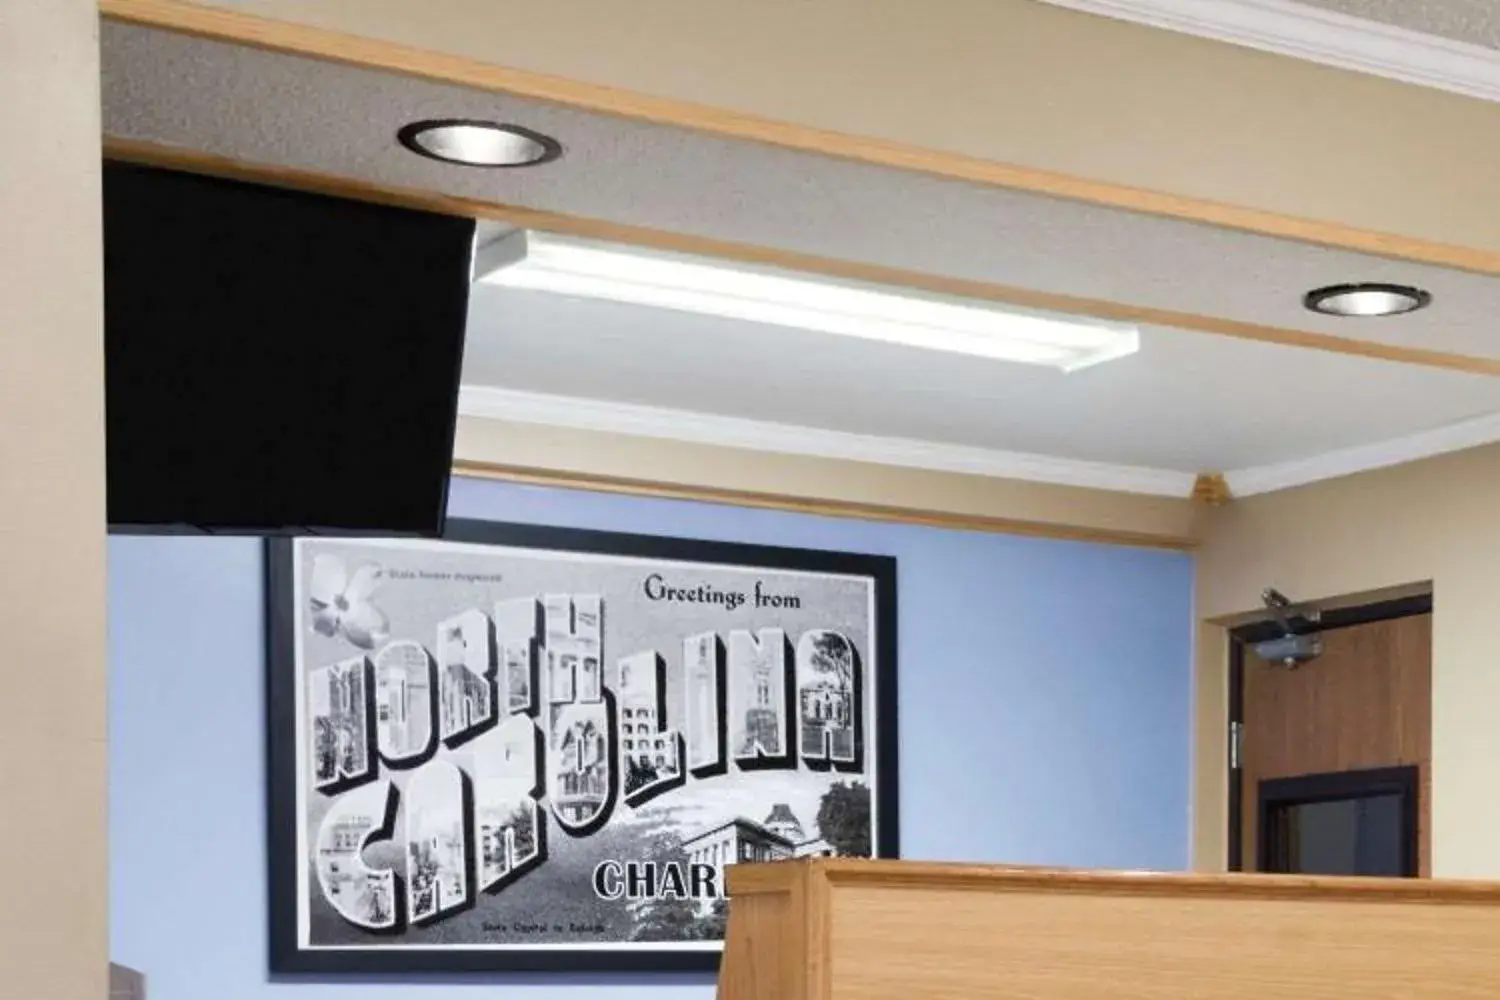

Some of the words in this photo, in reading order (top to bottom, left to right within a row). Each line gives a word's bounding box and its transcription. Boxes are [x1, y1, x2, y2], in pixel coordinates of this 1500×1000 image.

[643, 573, 745, 611] Greetings
[755, 580, 801, 609] from
[309, 592, 608, 797] NORTH
[315, 628, 865, 932] CAROLINA
[592, 859, 732, 901] CHAR
